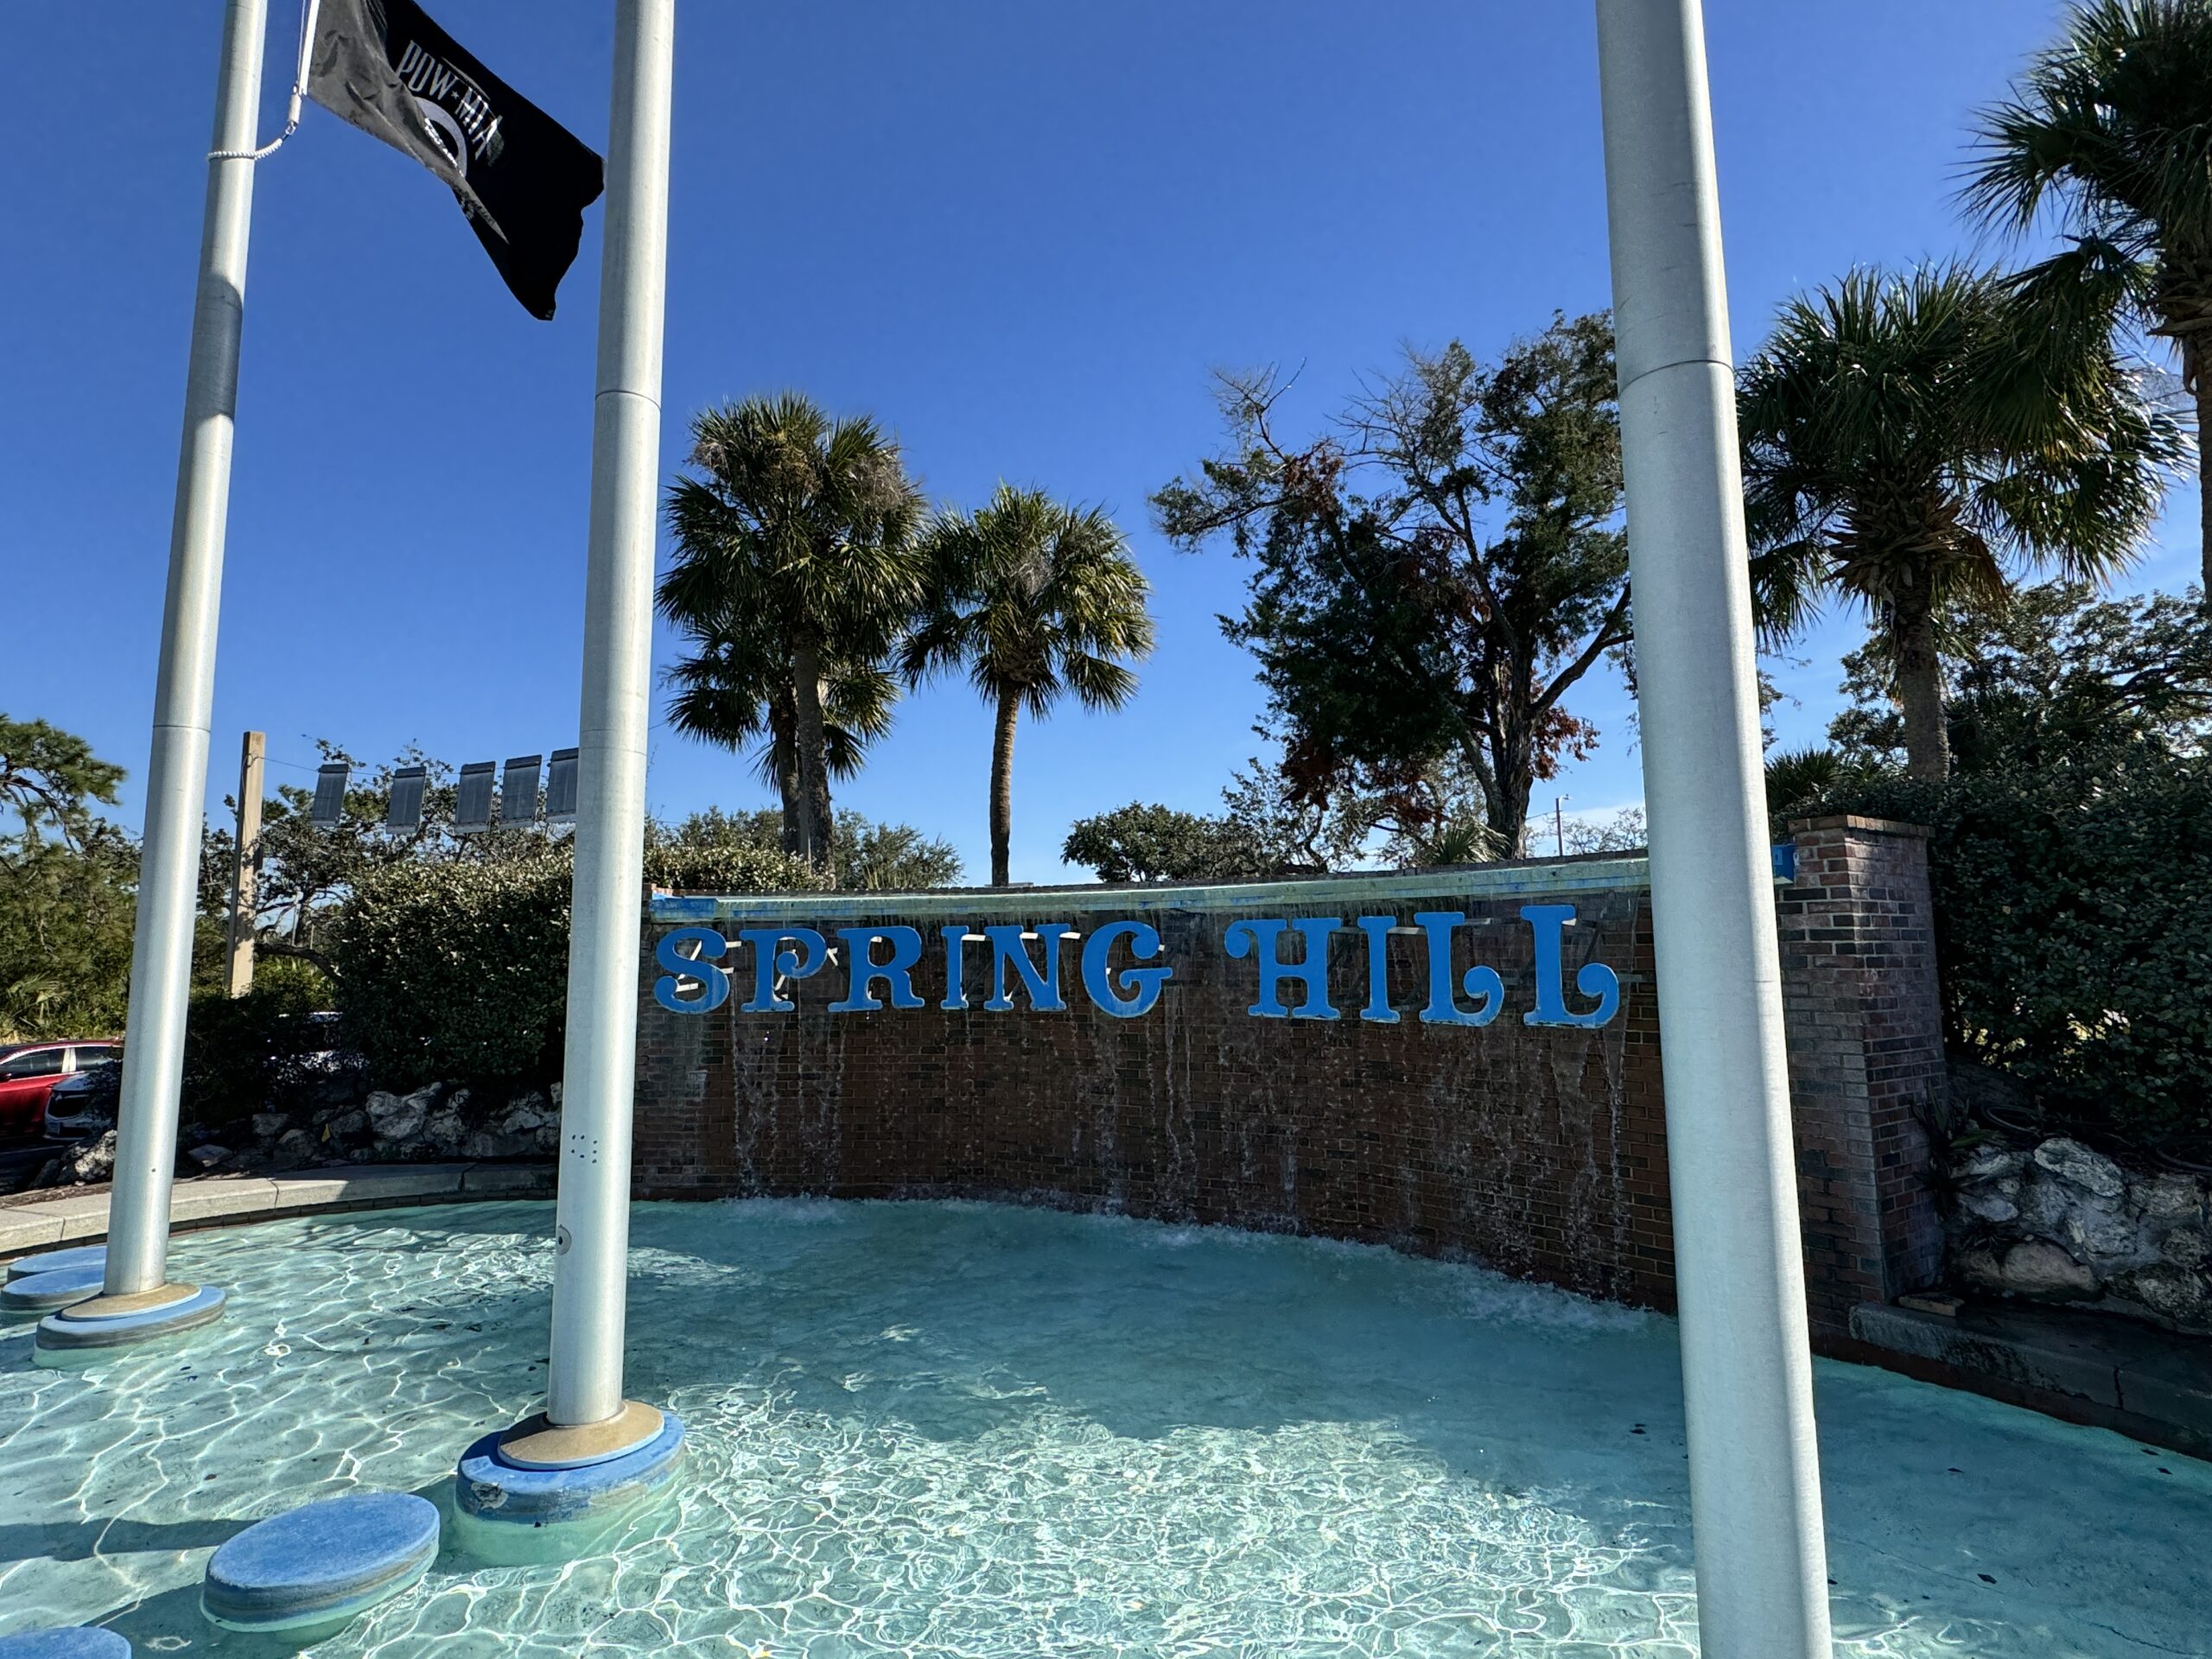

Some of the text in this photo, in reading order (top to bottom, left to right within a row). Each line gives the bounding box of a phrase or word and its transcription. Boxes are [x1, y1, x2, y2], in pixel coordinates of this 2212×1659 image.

[396, 40, 459, 101] POW
[653, 905, 1619, 1028] SPRING HILL
